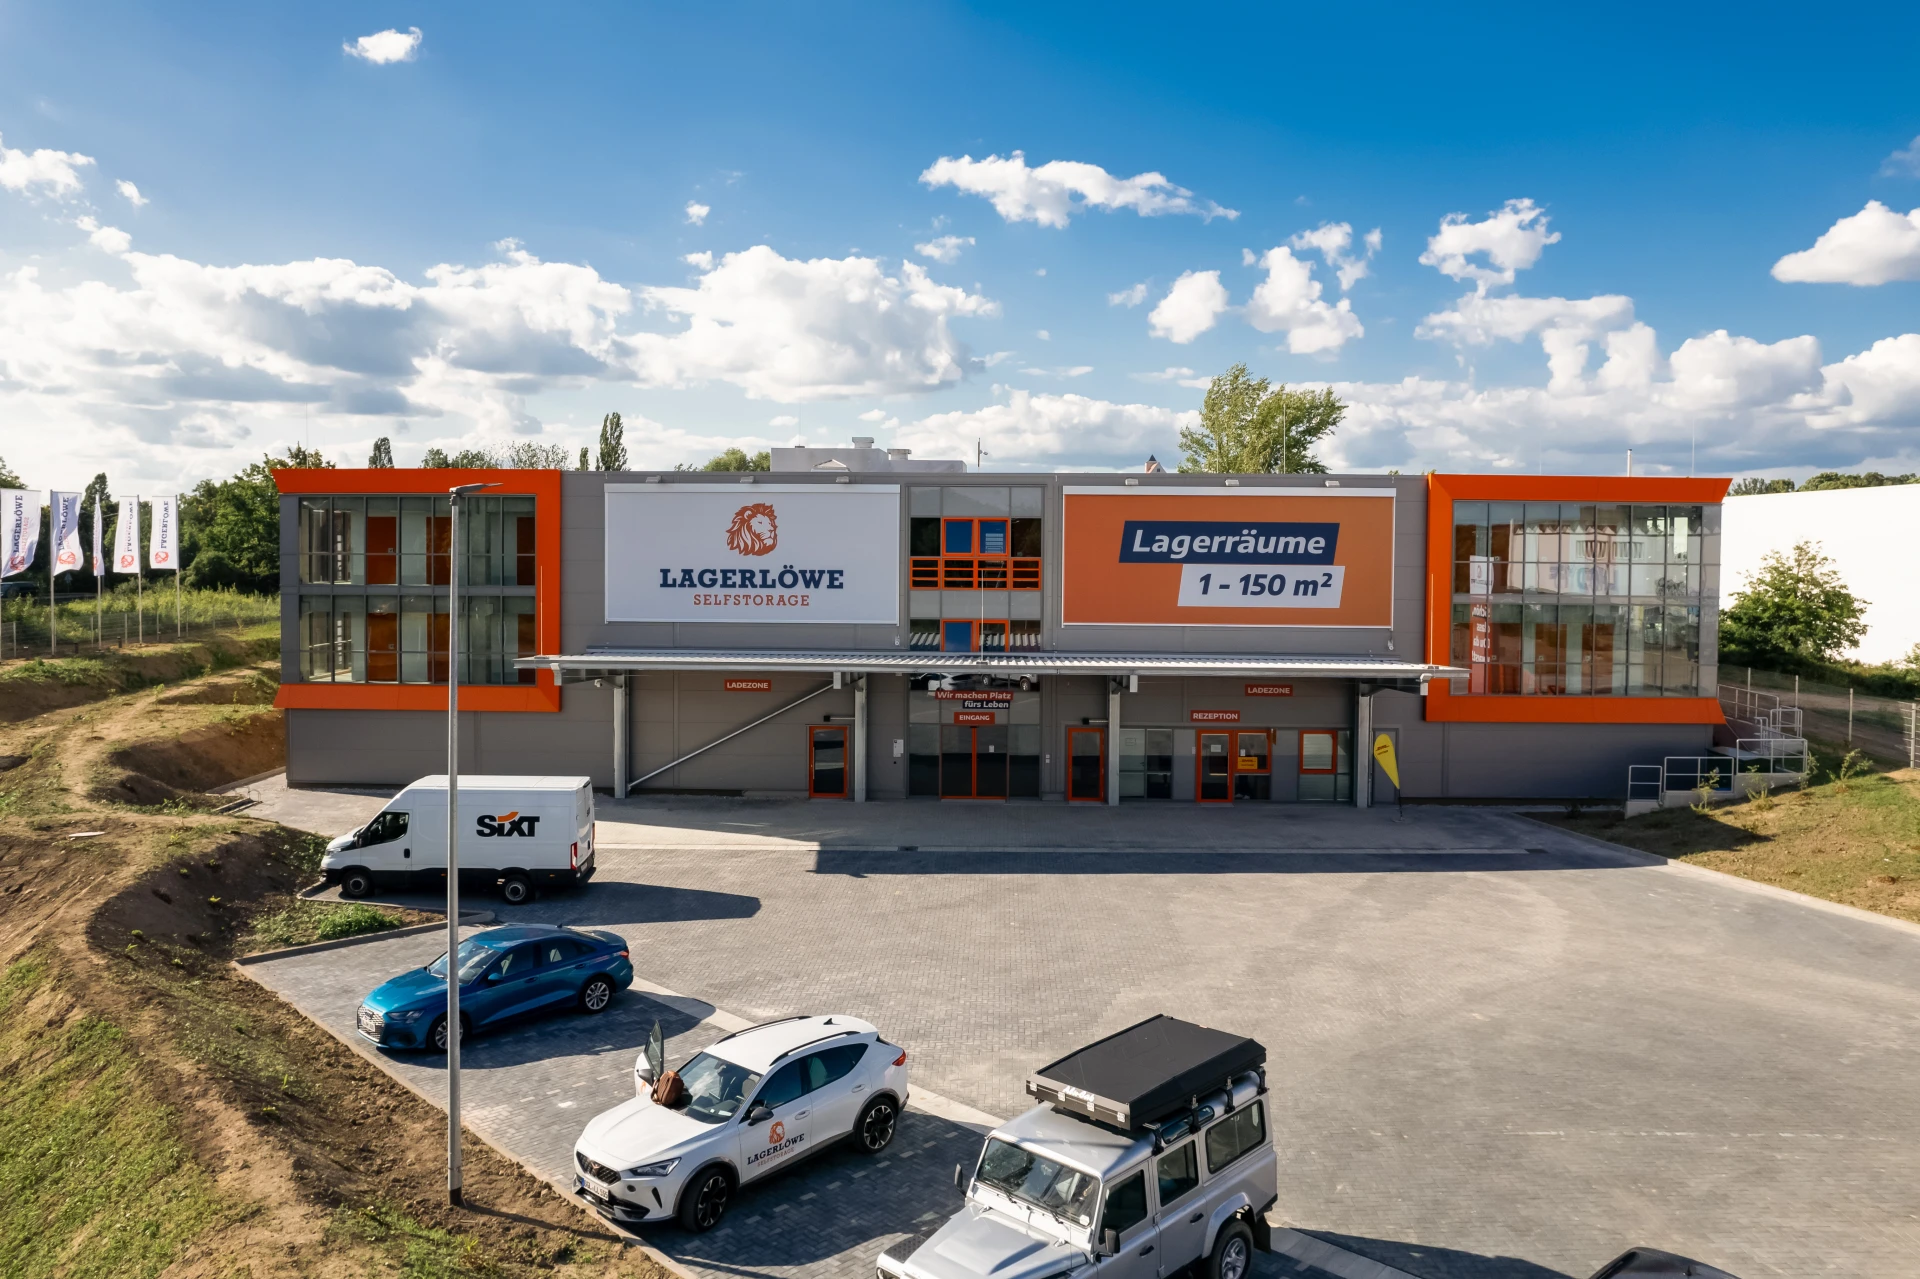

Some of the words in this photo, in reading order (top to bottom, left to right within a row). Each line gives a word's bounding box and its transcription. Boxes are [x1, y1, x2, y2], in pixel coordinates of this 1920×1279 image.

[13, 495, 23, 553] LAGERLÖWE
[1132, 529, 1326, 559] Lagerräume
[659, 564, 844, 589] LAGERLÖWE
[1198, 573, 1212, 595] 1
[1238, 573, 1286, 596] 150
[693, 594, 810, 607] SELFSTORAGE
[937, 691, 954, 699] Wir
[955, 691, 988, 699] machen
[989, 692, 1012, 700] Platz
[747, 1133, 805, 1165] LAGERLÖWE
[757, 1147, 795, 1167] SELFSTORAGE
